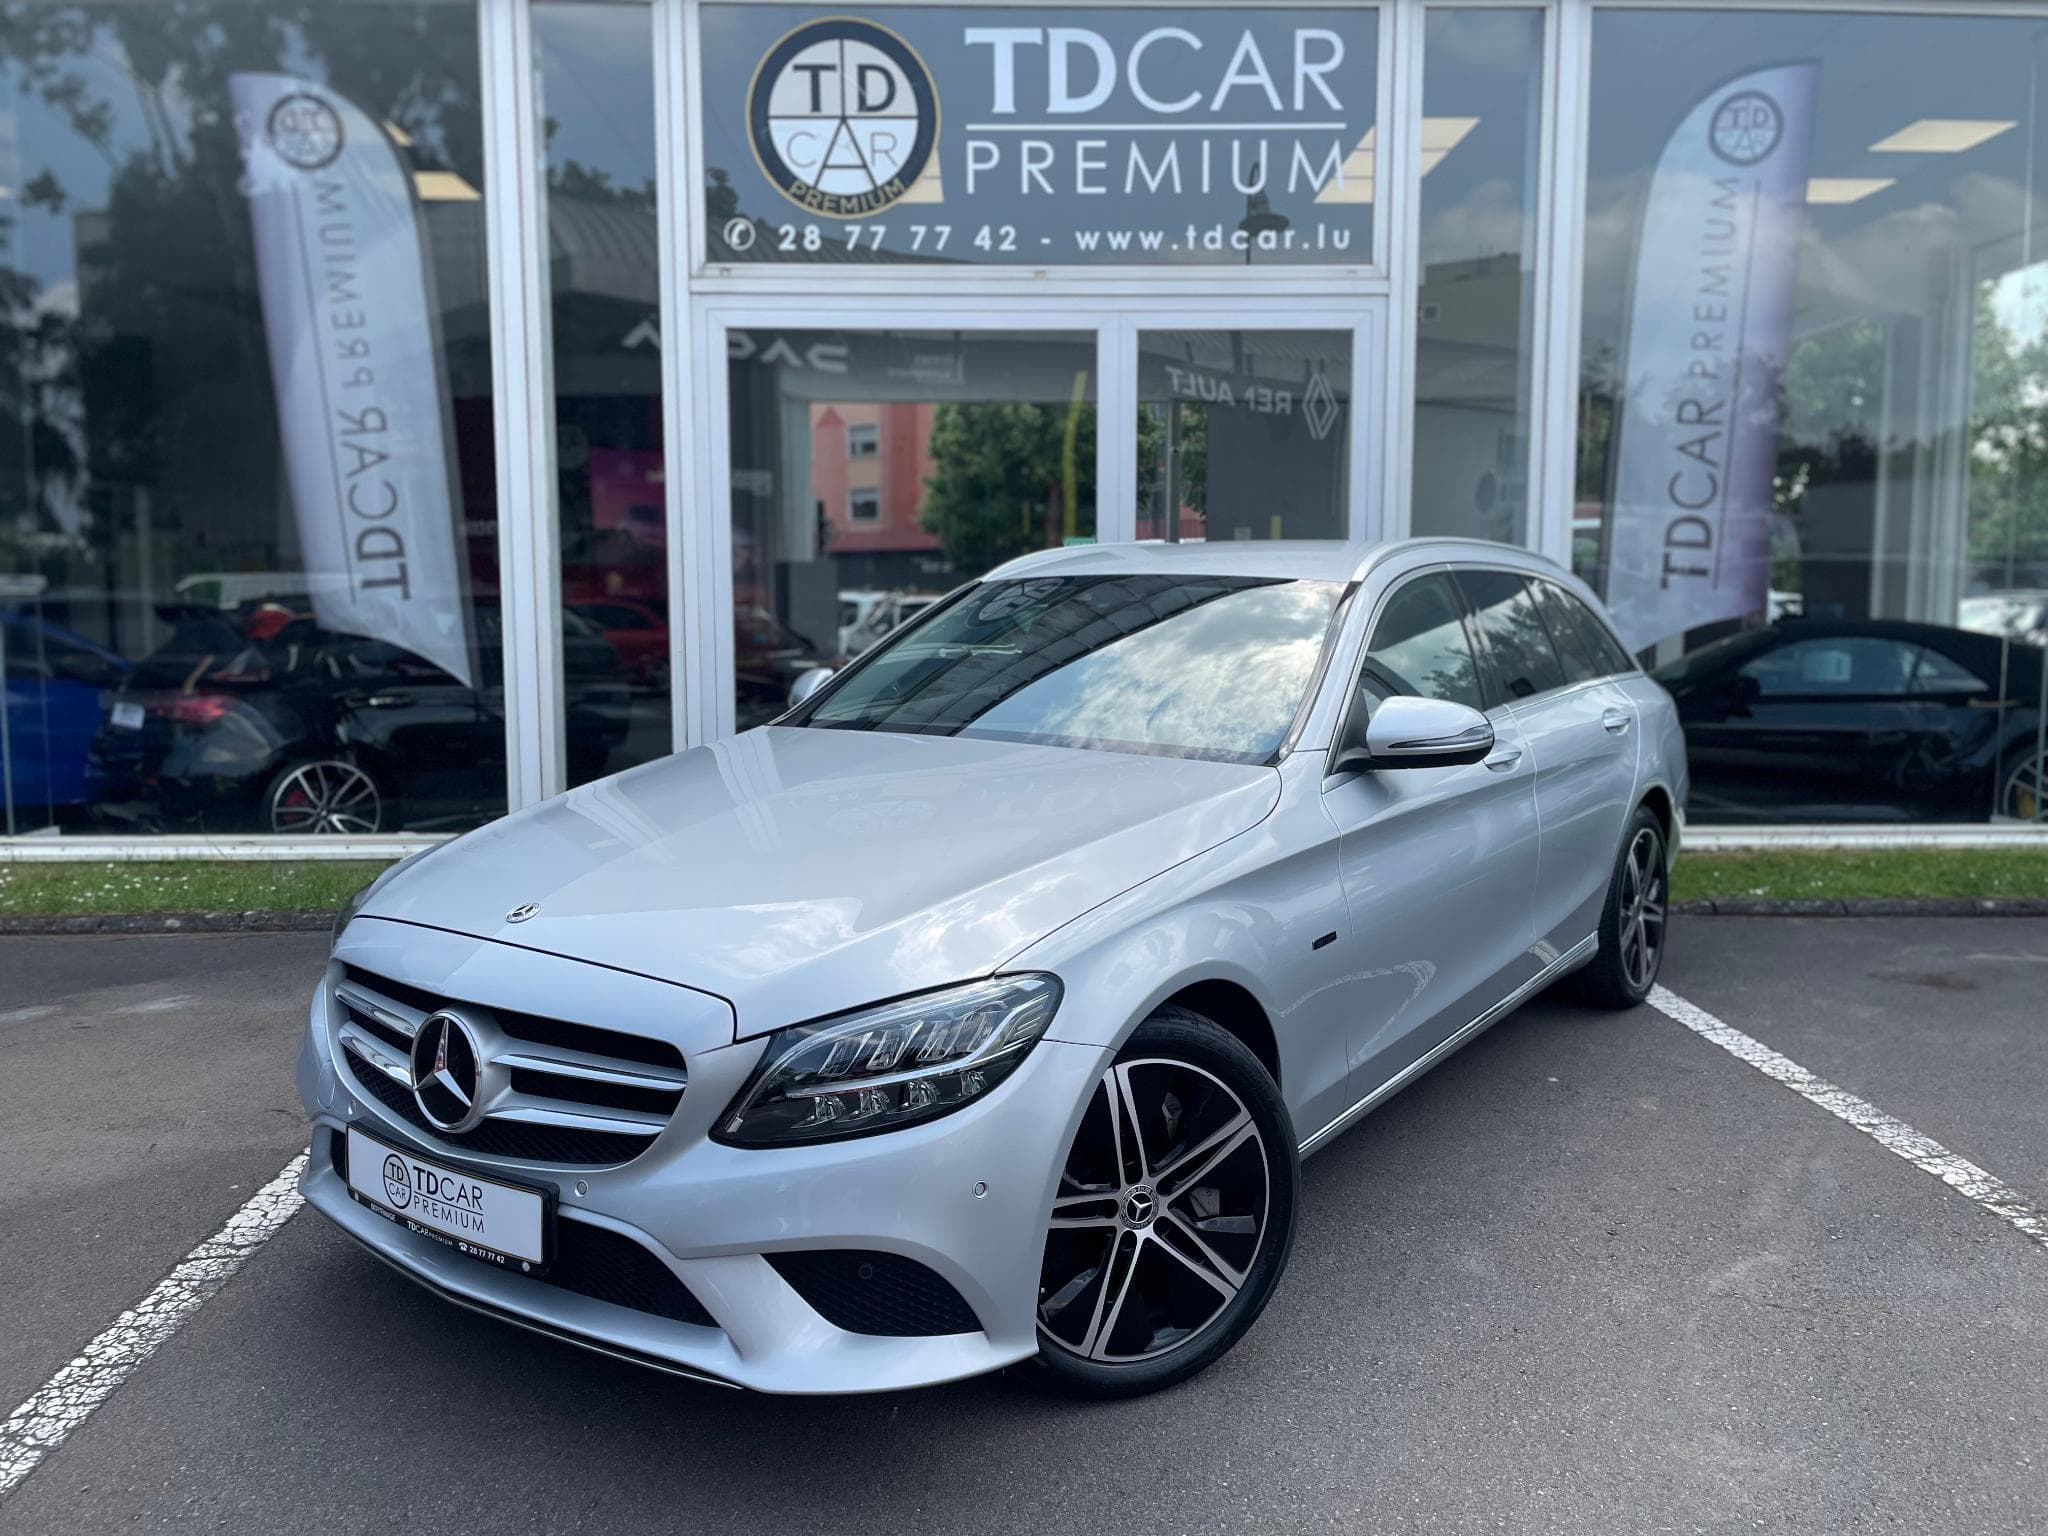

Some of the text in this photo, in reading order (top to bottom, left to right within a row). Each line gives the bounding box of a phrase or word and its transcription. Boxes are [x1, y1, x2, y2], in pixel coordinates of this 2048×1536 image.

[793, 63, 896, 113] TD
[964, 27, 1346, 114] TDCAR
[786, 119, 898, 189] CAR
[965, 139, 1346, 195] PREMIUM
[788, 178, 905, 215] PREMIUM
[778, 226, 821, 252] 28
[845, 226, 885, 252] 77
[911, 226, 951, 252] 77
[974, 226, 1017, 252] 42
[1076, 223, 1351, 252] www.tdcar.lu
[1661, 178, 1738, 590] TDCAR PREMIUM
[388, 1183, 406, 1200] CAR
[389, 1162, 404, 1181] TD
[413, 1166, 483, 1210] TDCAR
[413, 1196, 485, 1234] PREMIUM
